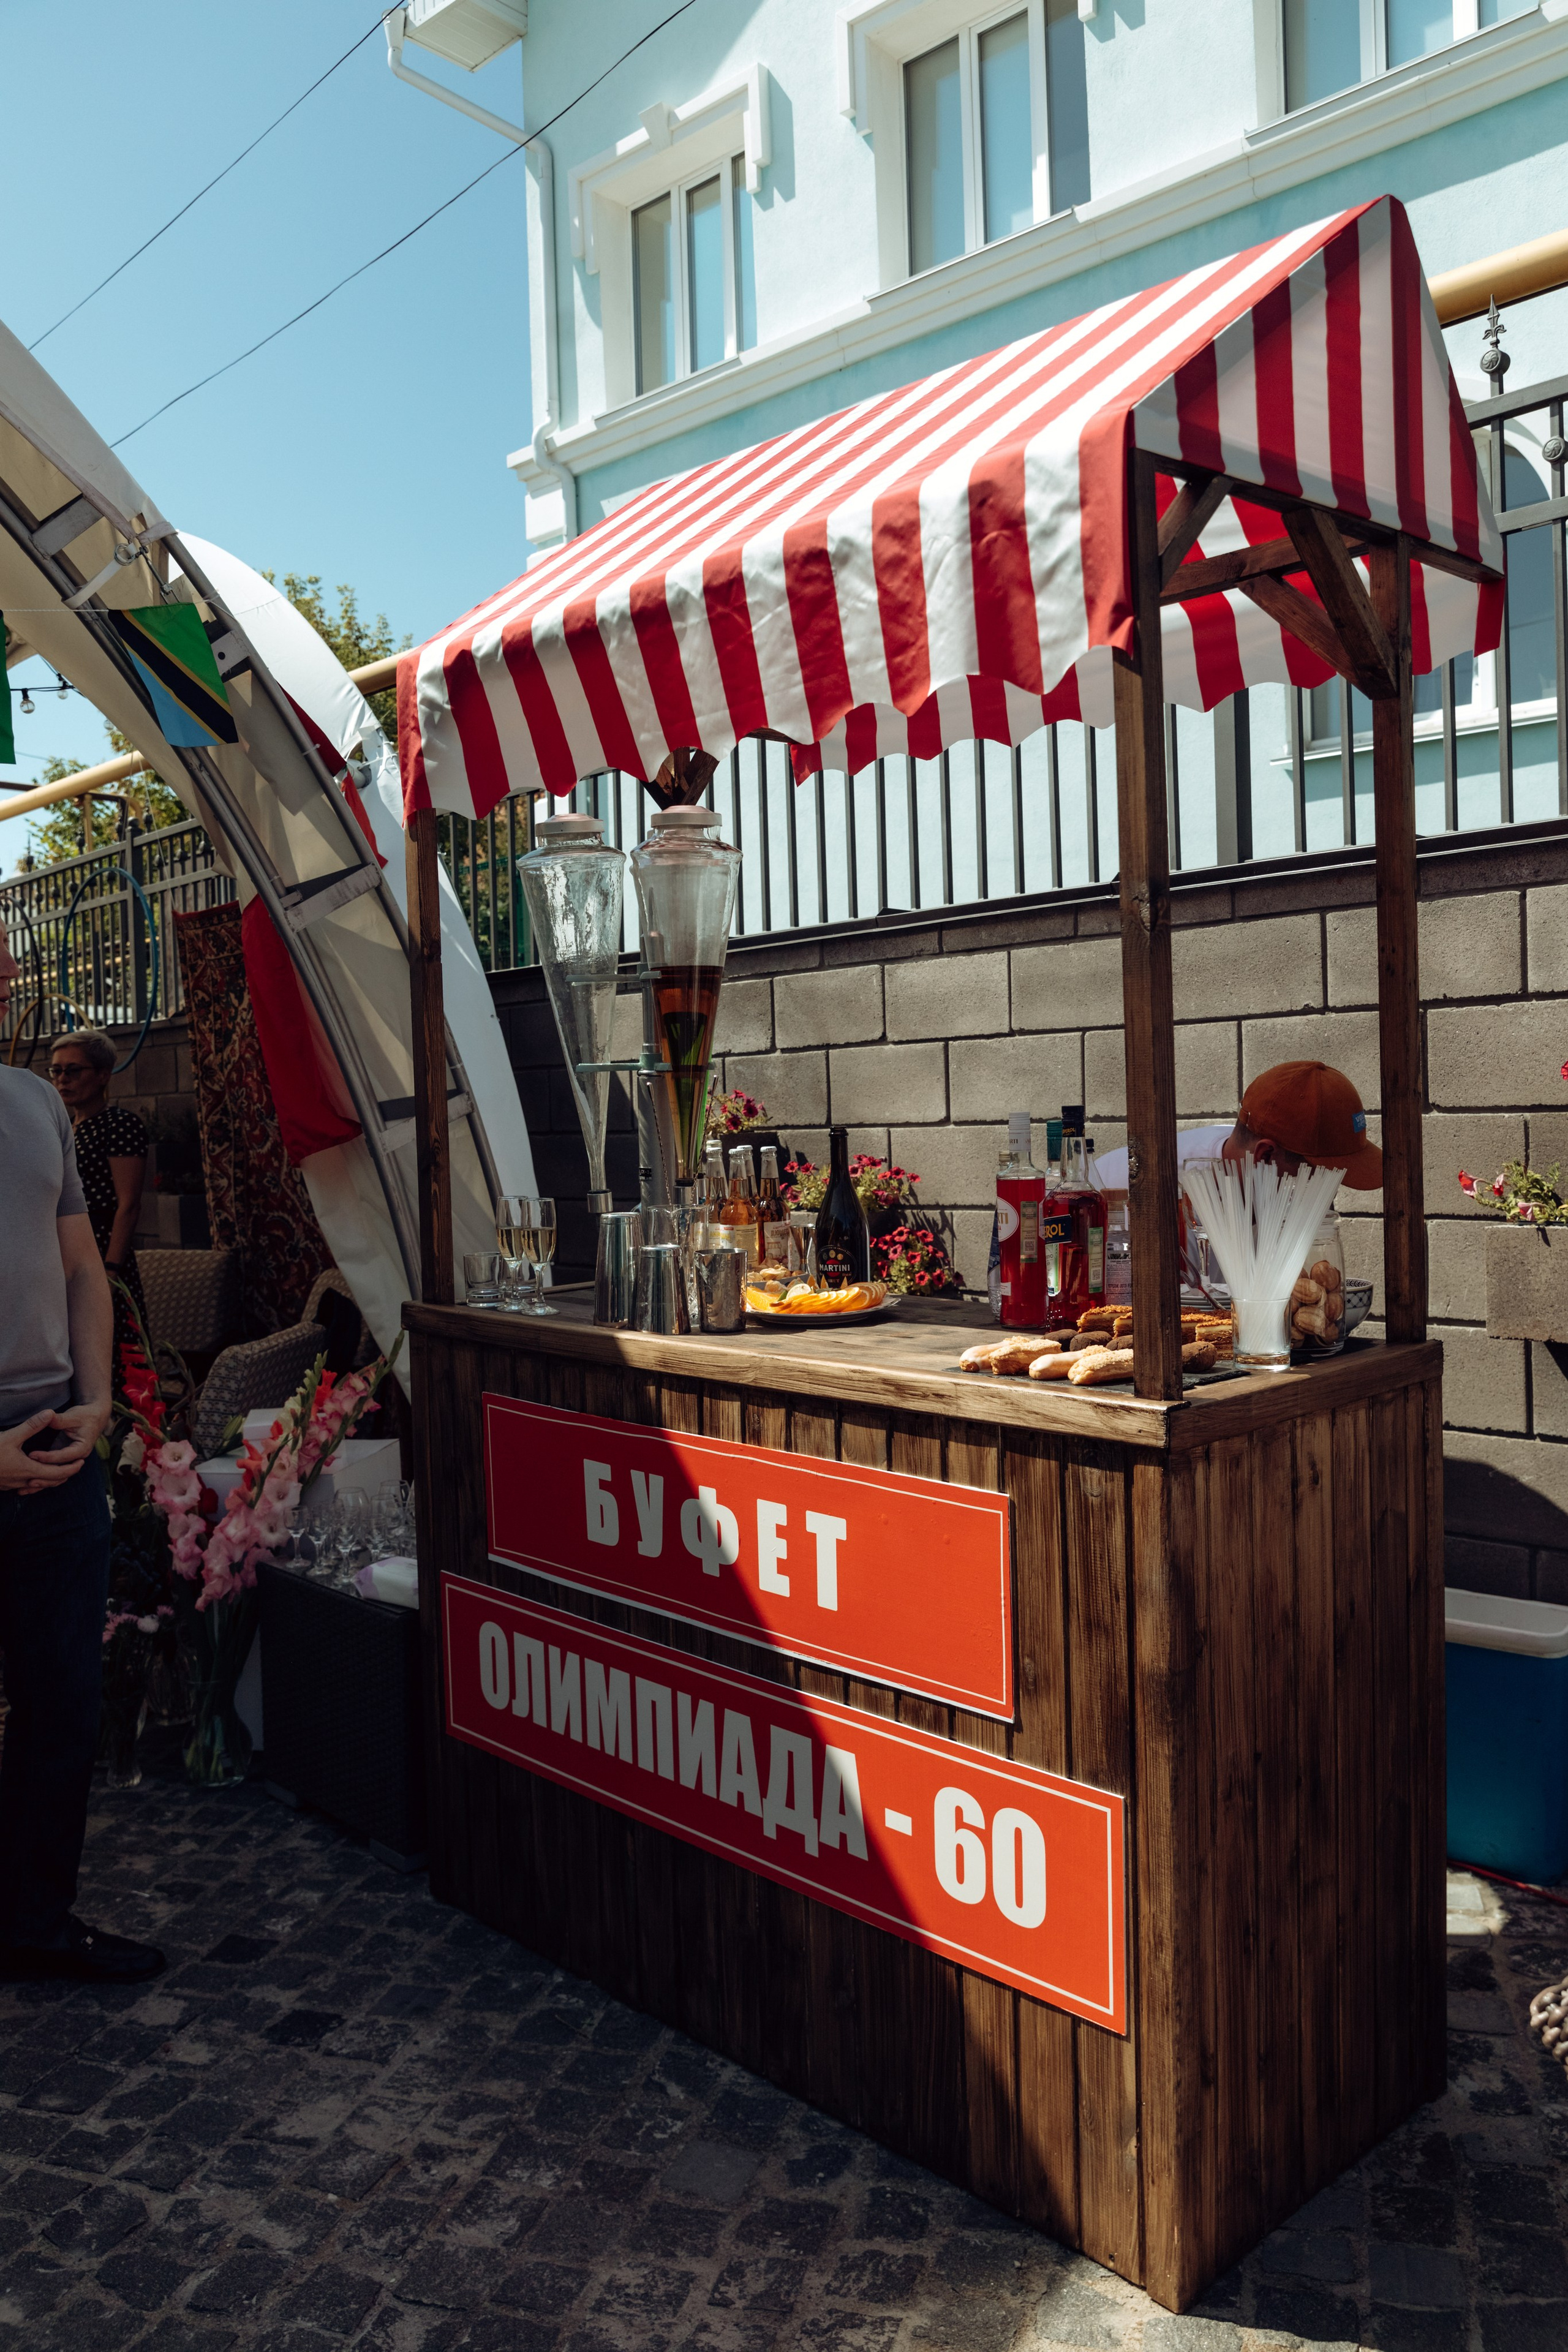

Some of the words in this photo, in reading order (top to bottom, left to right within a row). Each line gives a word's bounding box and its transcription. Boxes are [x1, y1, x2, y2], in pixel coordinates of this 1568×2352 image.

[820, 1264, 850, 1272] MARTINI
[582, 1459, 847, 1611] БУФЕТ
[478, 1620, 869, 1861] ОЛИМПИАДА
[933, 1786, 1047, 1929] 60
